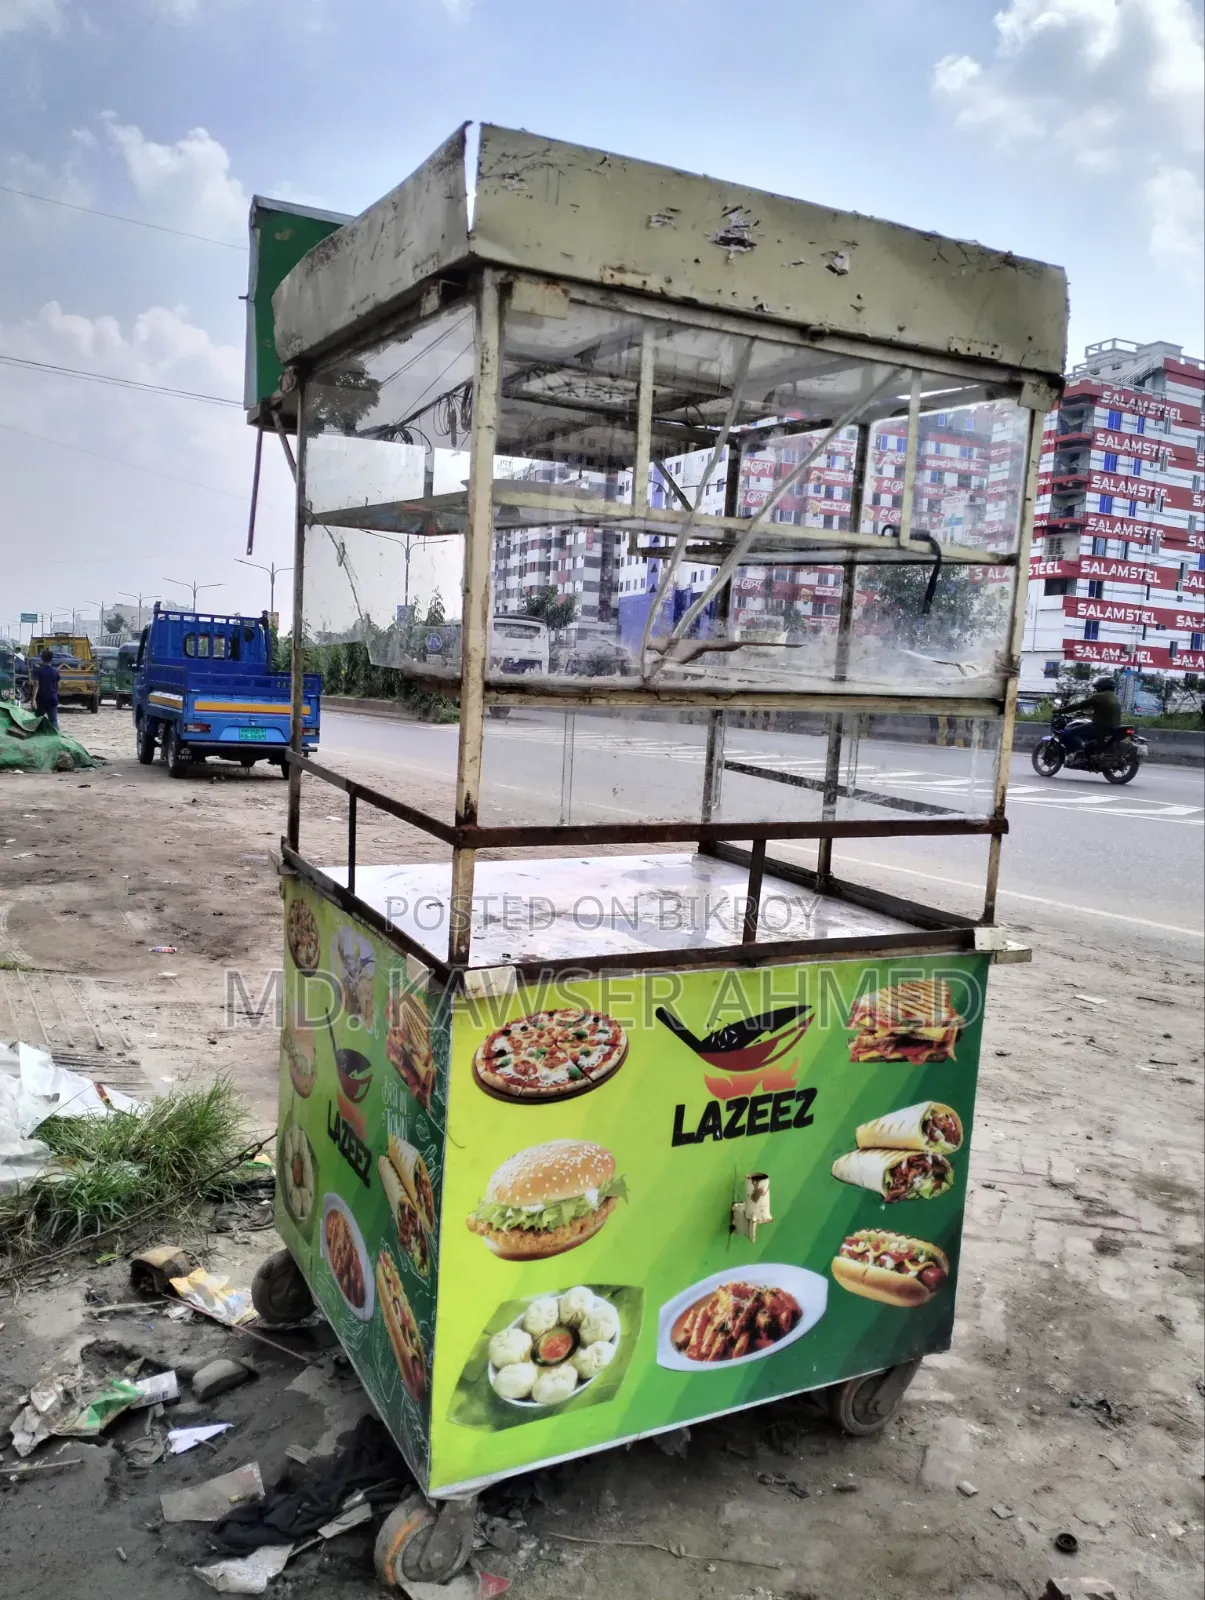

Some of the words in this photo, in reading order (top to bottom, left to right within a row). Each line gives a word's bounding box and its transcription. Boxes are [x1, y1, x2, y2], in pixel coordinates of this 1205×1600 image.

[1101, 391, 1184, 421] SALAMSTEEL
[327, 1099, 372, 1190] LAZEEZ
[671, 1087, 818, 1148] LAZEEZ
